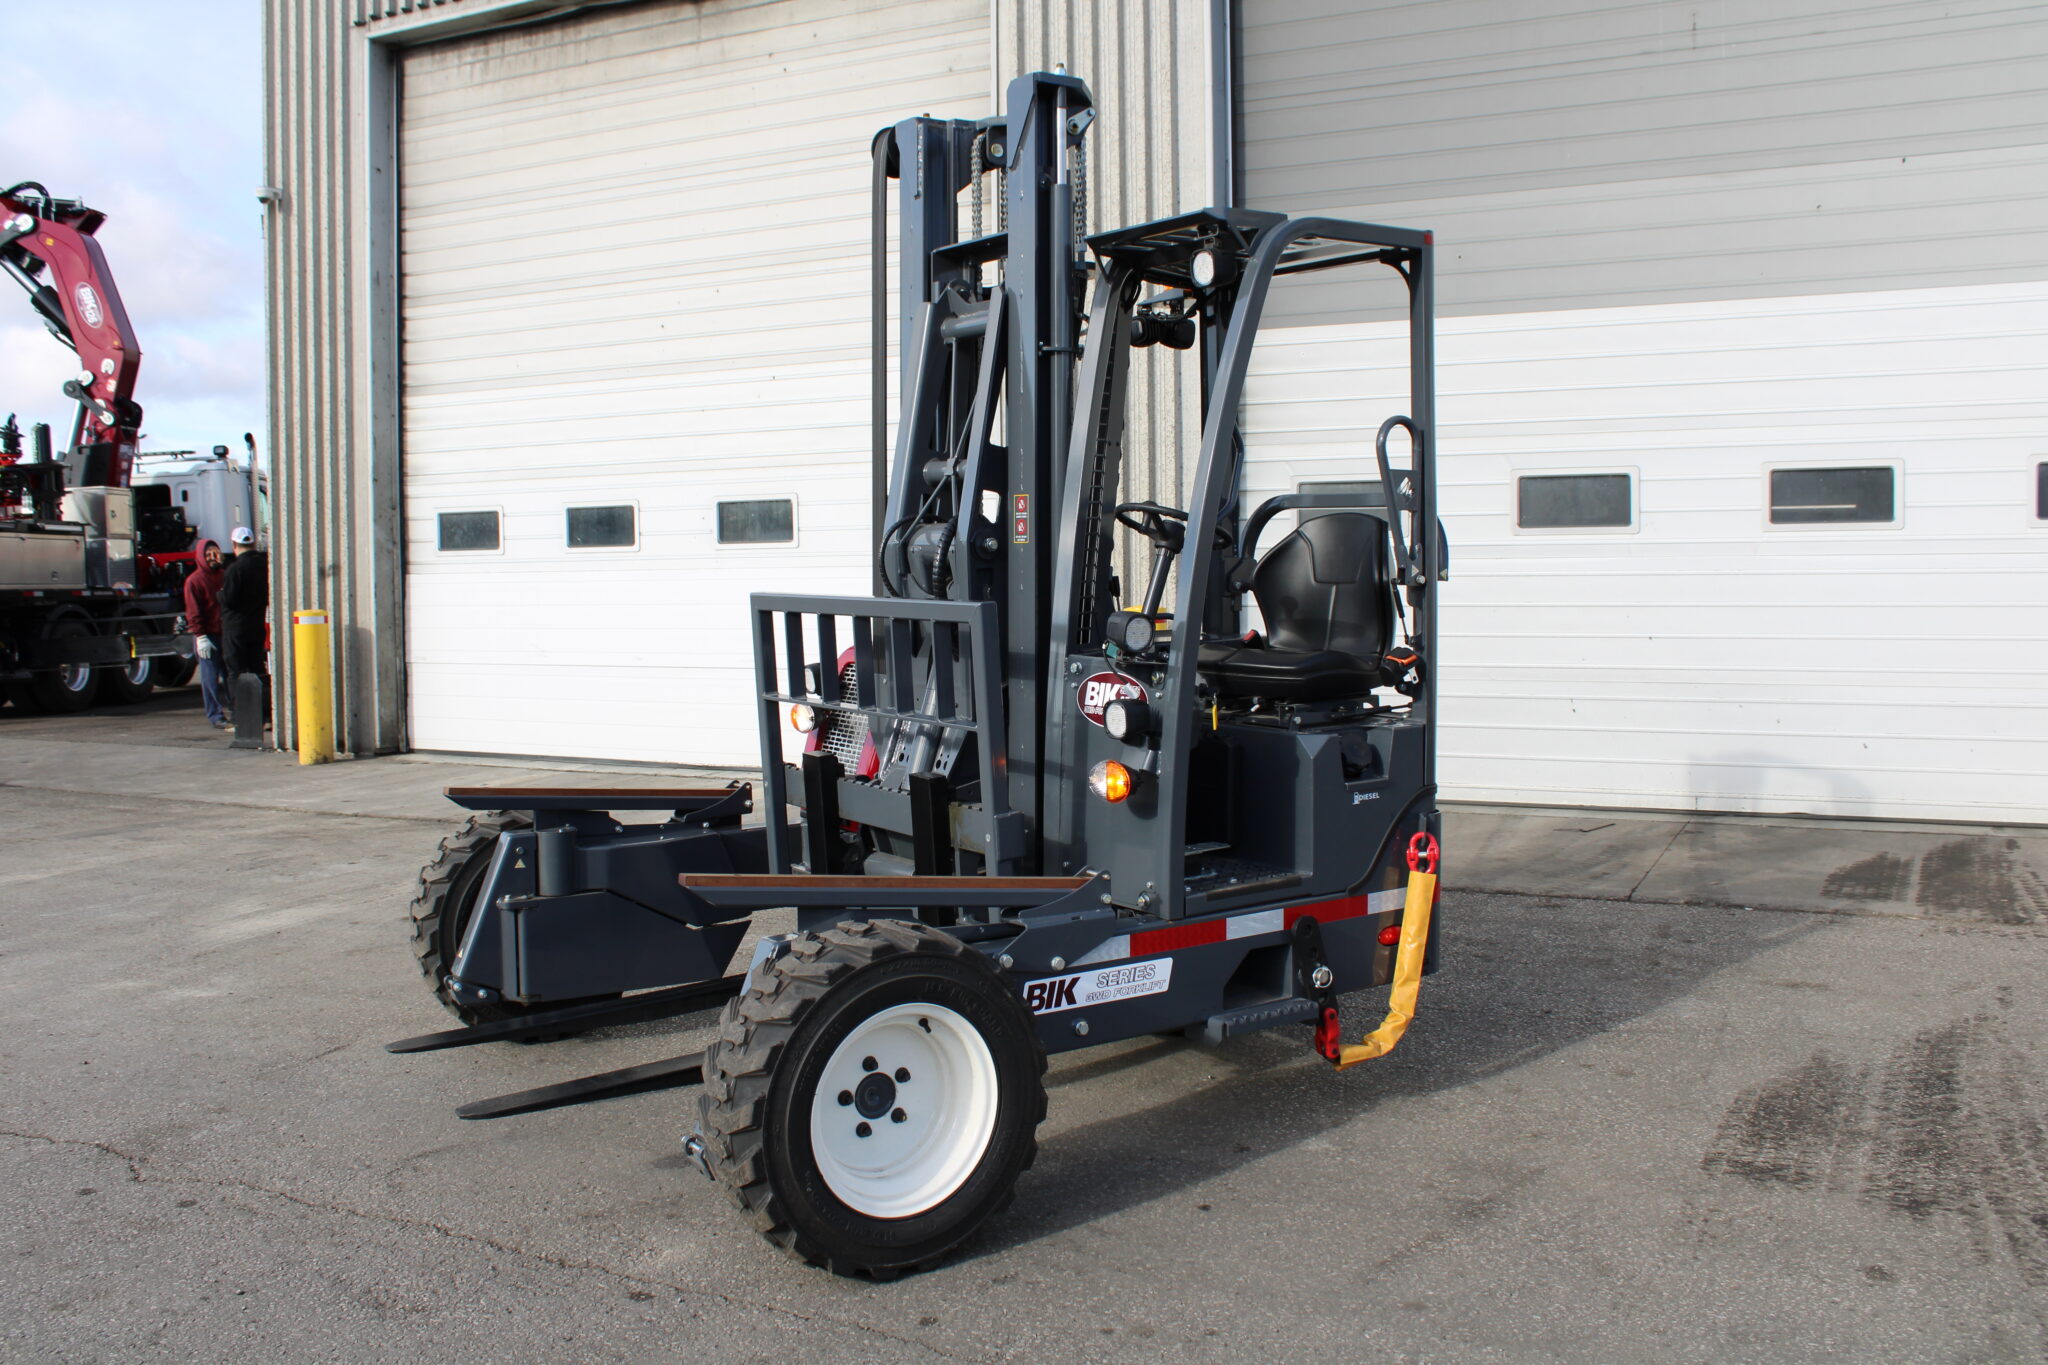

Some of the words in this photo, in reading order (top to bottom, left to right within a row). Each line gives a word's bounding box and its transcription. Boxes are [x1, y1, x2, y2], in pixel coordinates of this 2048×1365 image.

[1084, 681, 1121, 707] BIK
[1359, 792, 1380, 801] DIESEL
[1097, 964, 1156, 988] SERIES
[1027, 976, 1081, 1012] BIK
[1113, 979, 1167, 998] FORKLIFT
